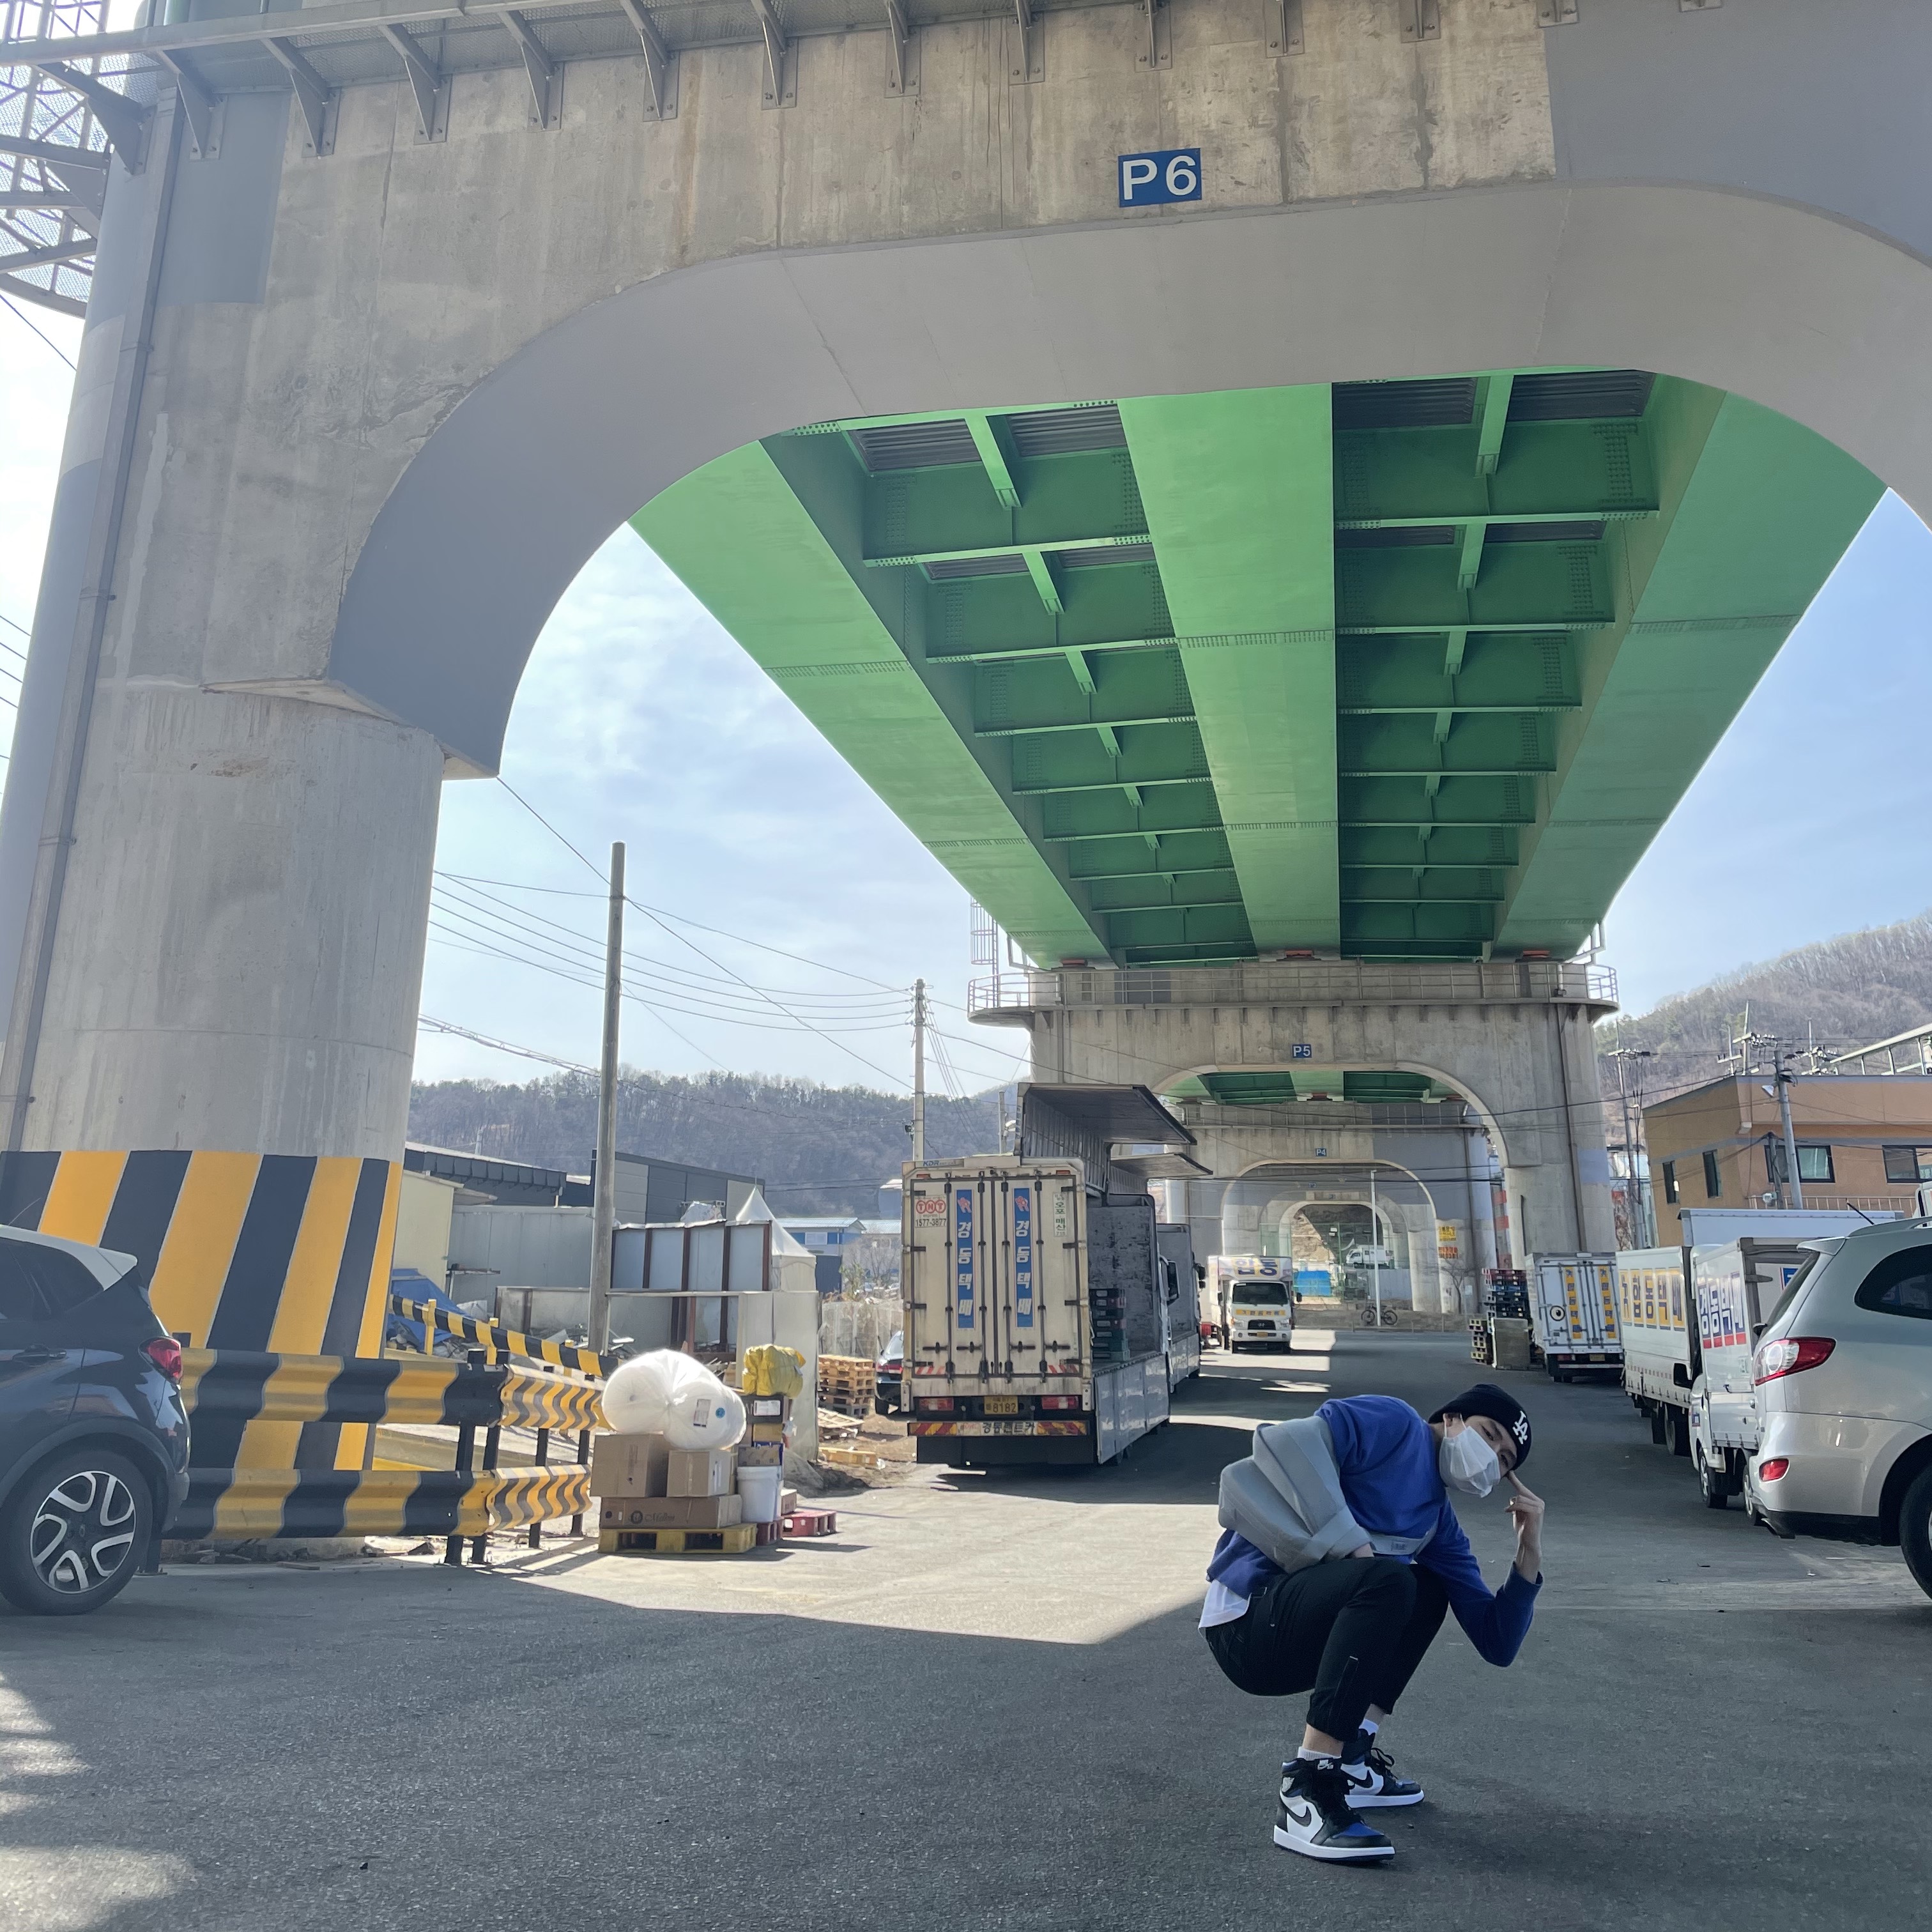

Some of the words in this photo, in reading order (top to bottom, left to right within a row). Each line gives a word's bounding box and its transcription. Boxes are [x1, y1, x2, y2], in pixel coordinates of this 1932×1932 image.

[1292, 1045, 1311, 1057] P5
[917, 1200, 946, 1213] TNT
[916, 1218, 947, 1227] 1577-3877
[958, 1221, 973, 1316] 경동택배
[1016, 1220, 1032, 1315] 경동택배
[993, 1402, 1016, 1413] 8182
[1512, 1410, 1528, 1444] LA
